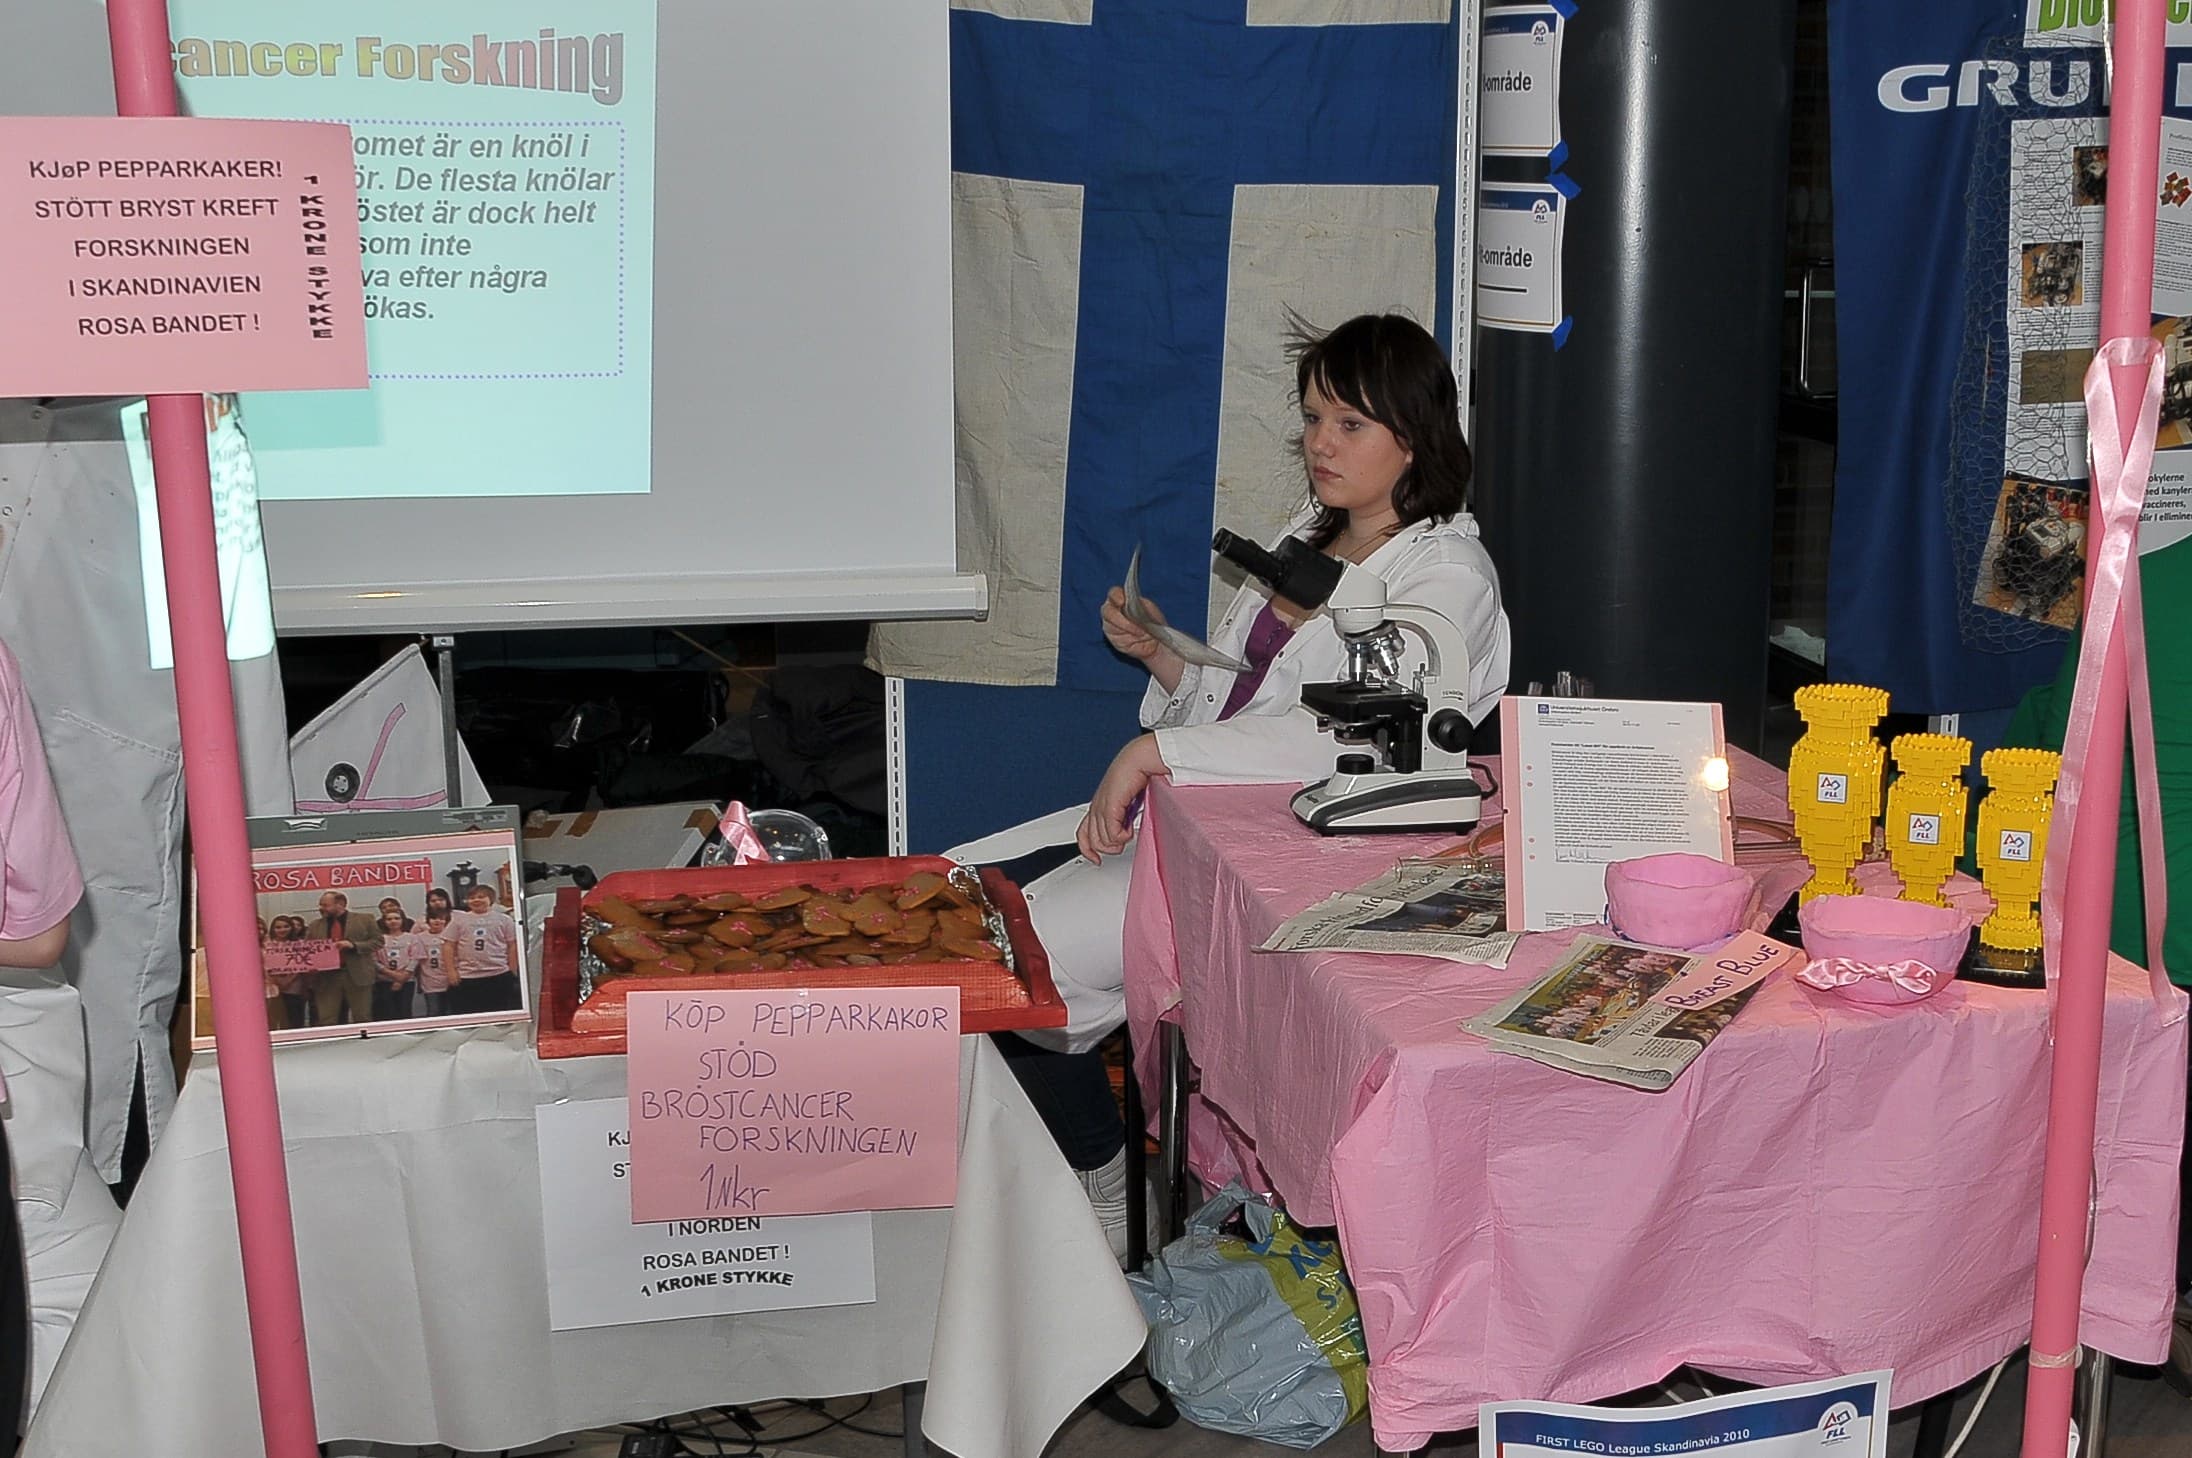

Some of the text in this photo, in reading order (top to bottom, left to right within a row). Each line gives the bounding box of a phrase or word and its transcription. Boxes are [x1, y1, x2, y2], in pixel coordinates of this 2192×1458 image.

[169, 28, 624, 106] ancer Forskning
[1878, 60, 2111, 112] GRU
[352, 133, 590, 159] omet är en knöl i
[98, 160, 283, 178] PEPPARKAKER!
[395, 166, 432, 191] De
[441, 168, 517, 192] flesta
[525, 167, 616, 192] knölar
[35, 196, 280, 218] STÖTT BRYST KREFT
[432, 200, 461, 224] är
[468, 201, 535, 224] dock
[543, 200, 597, 224] helt
[300, 194, 328, 256] KRONE
[74, 237, 251, 258] FORSKNINGEN
[420, 233, 472, 256] inte
[68, 275, 262, 297] I SKANDINAVIEN
[399, 265, 462, 289] efter
[469, 265, 548, 294] några
[308, 266, 334, 339] STYKKE
[78, 317, 146, 336] ROSA
[152, 314, 247, 335] BANDET
[331, 863, 430, 885] BANDET
[475, 939, 484, 951] 9
[1716, 944, 1779, 976] BLUE
[753, 1002, 949, 1037] PEPPARKAKOR
[641, 1084, 855, 1121] BRÖSTCANCER
[608, 1131, 630, 1147] KJ
[699, 1125, 917, 1156] FORSKNINGEN
[613, 1162, 631, 1178] S
[668, 1217, 761, 1237] I NORDEN
[643, 1252, 697, 1270] ROSA
[702, 1246, 778, 1264] BANDET
[657, 1273, 718, 1293] KRONE
[722, 1270, 794, 1286] STYKKE
[1536, 1428, 1750, 1456] FIRST LEGO League Skandinavia 2010
[1826, 1427, 1847, 1438] FLL
